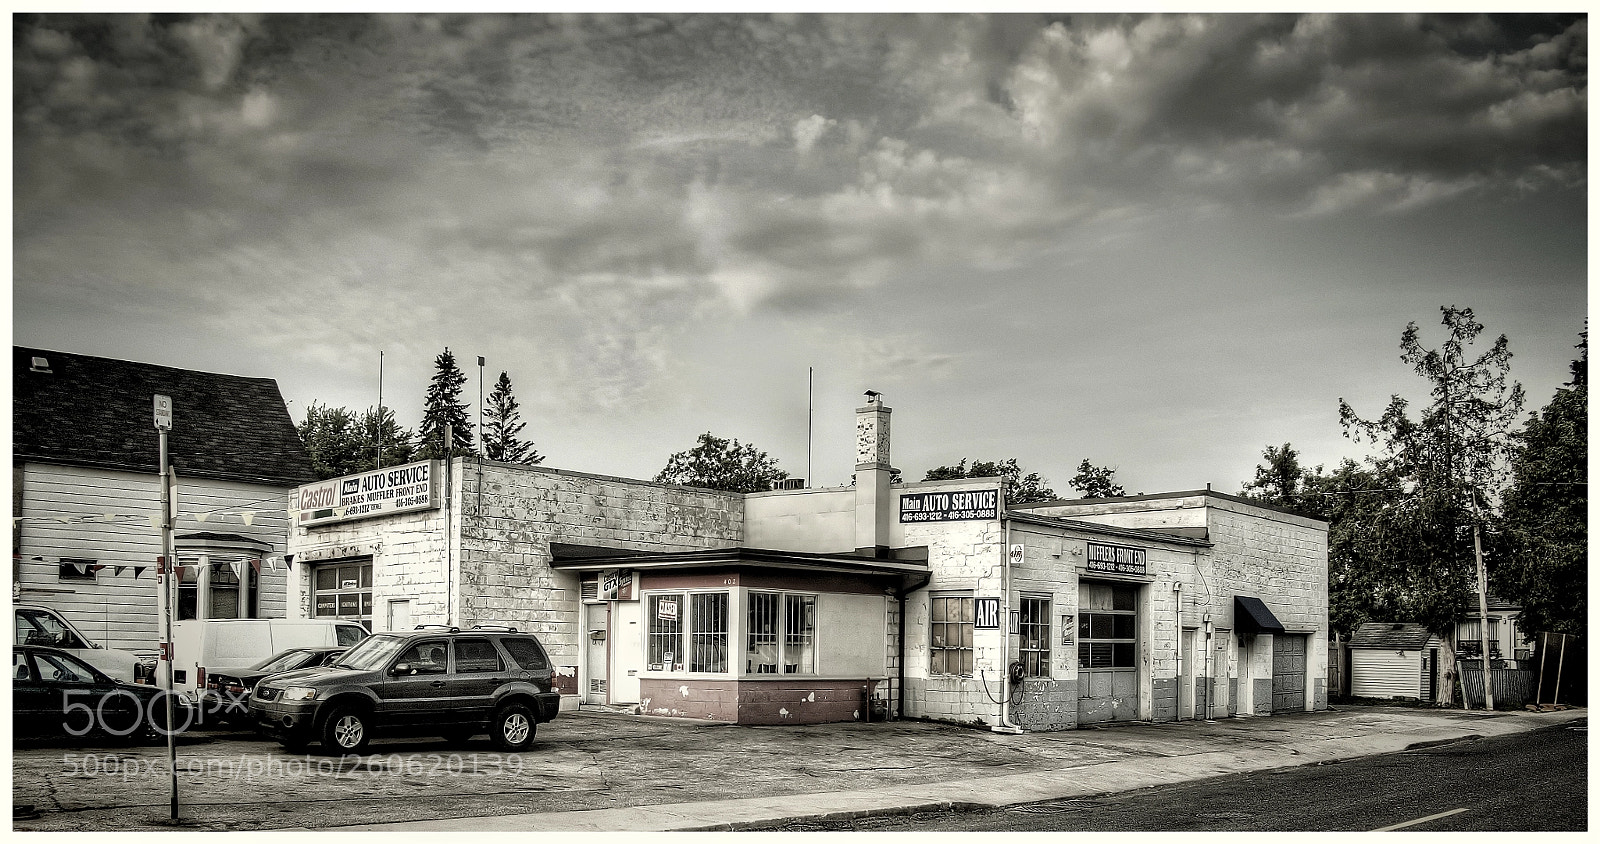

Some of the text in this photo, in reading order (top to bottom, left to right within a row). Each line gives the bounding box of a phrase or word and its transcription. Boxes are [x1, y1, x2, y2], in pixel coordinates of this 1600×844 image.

[159, 400, 167, 409] NO
[343, 464, 429, 493] Main AUTO SERVICE
[301, 483, 337, 511] Castrol
[341, 494, 364, 507] BRAKES
[366, 489, 395, 502] MUFFLER
[395, 485, 415, 498] FRONT
[415, 483, 428, 494] END
[902, 491, 996, 512] Main AUTO SERVICE
[901, 511, 943, 522] 416-693-1212
[948, 509, 995, 520] 416-305-0888
[1089, 544, 1145, 565] MUFFLERS FRONT END
[603, 579, 618, 592] GTX
[976, 599, 999, 627] AIR
